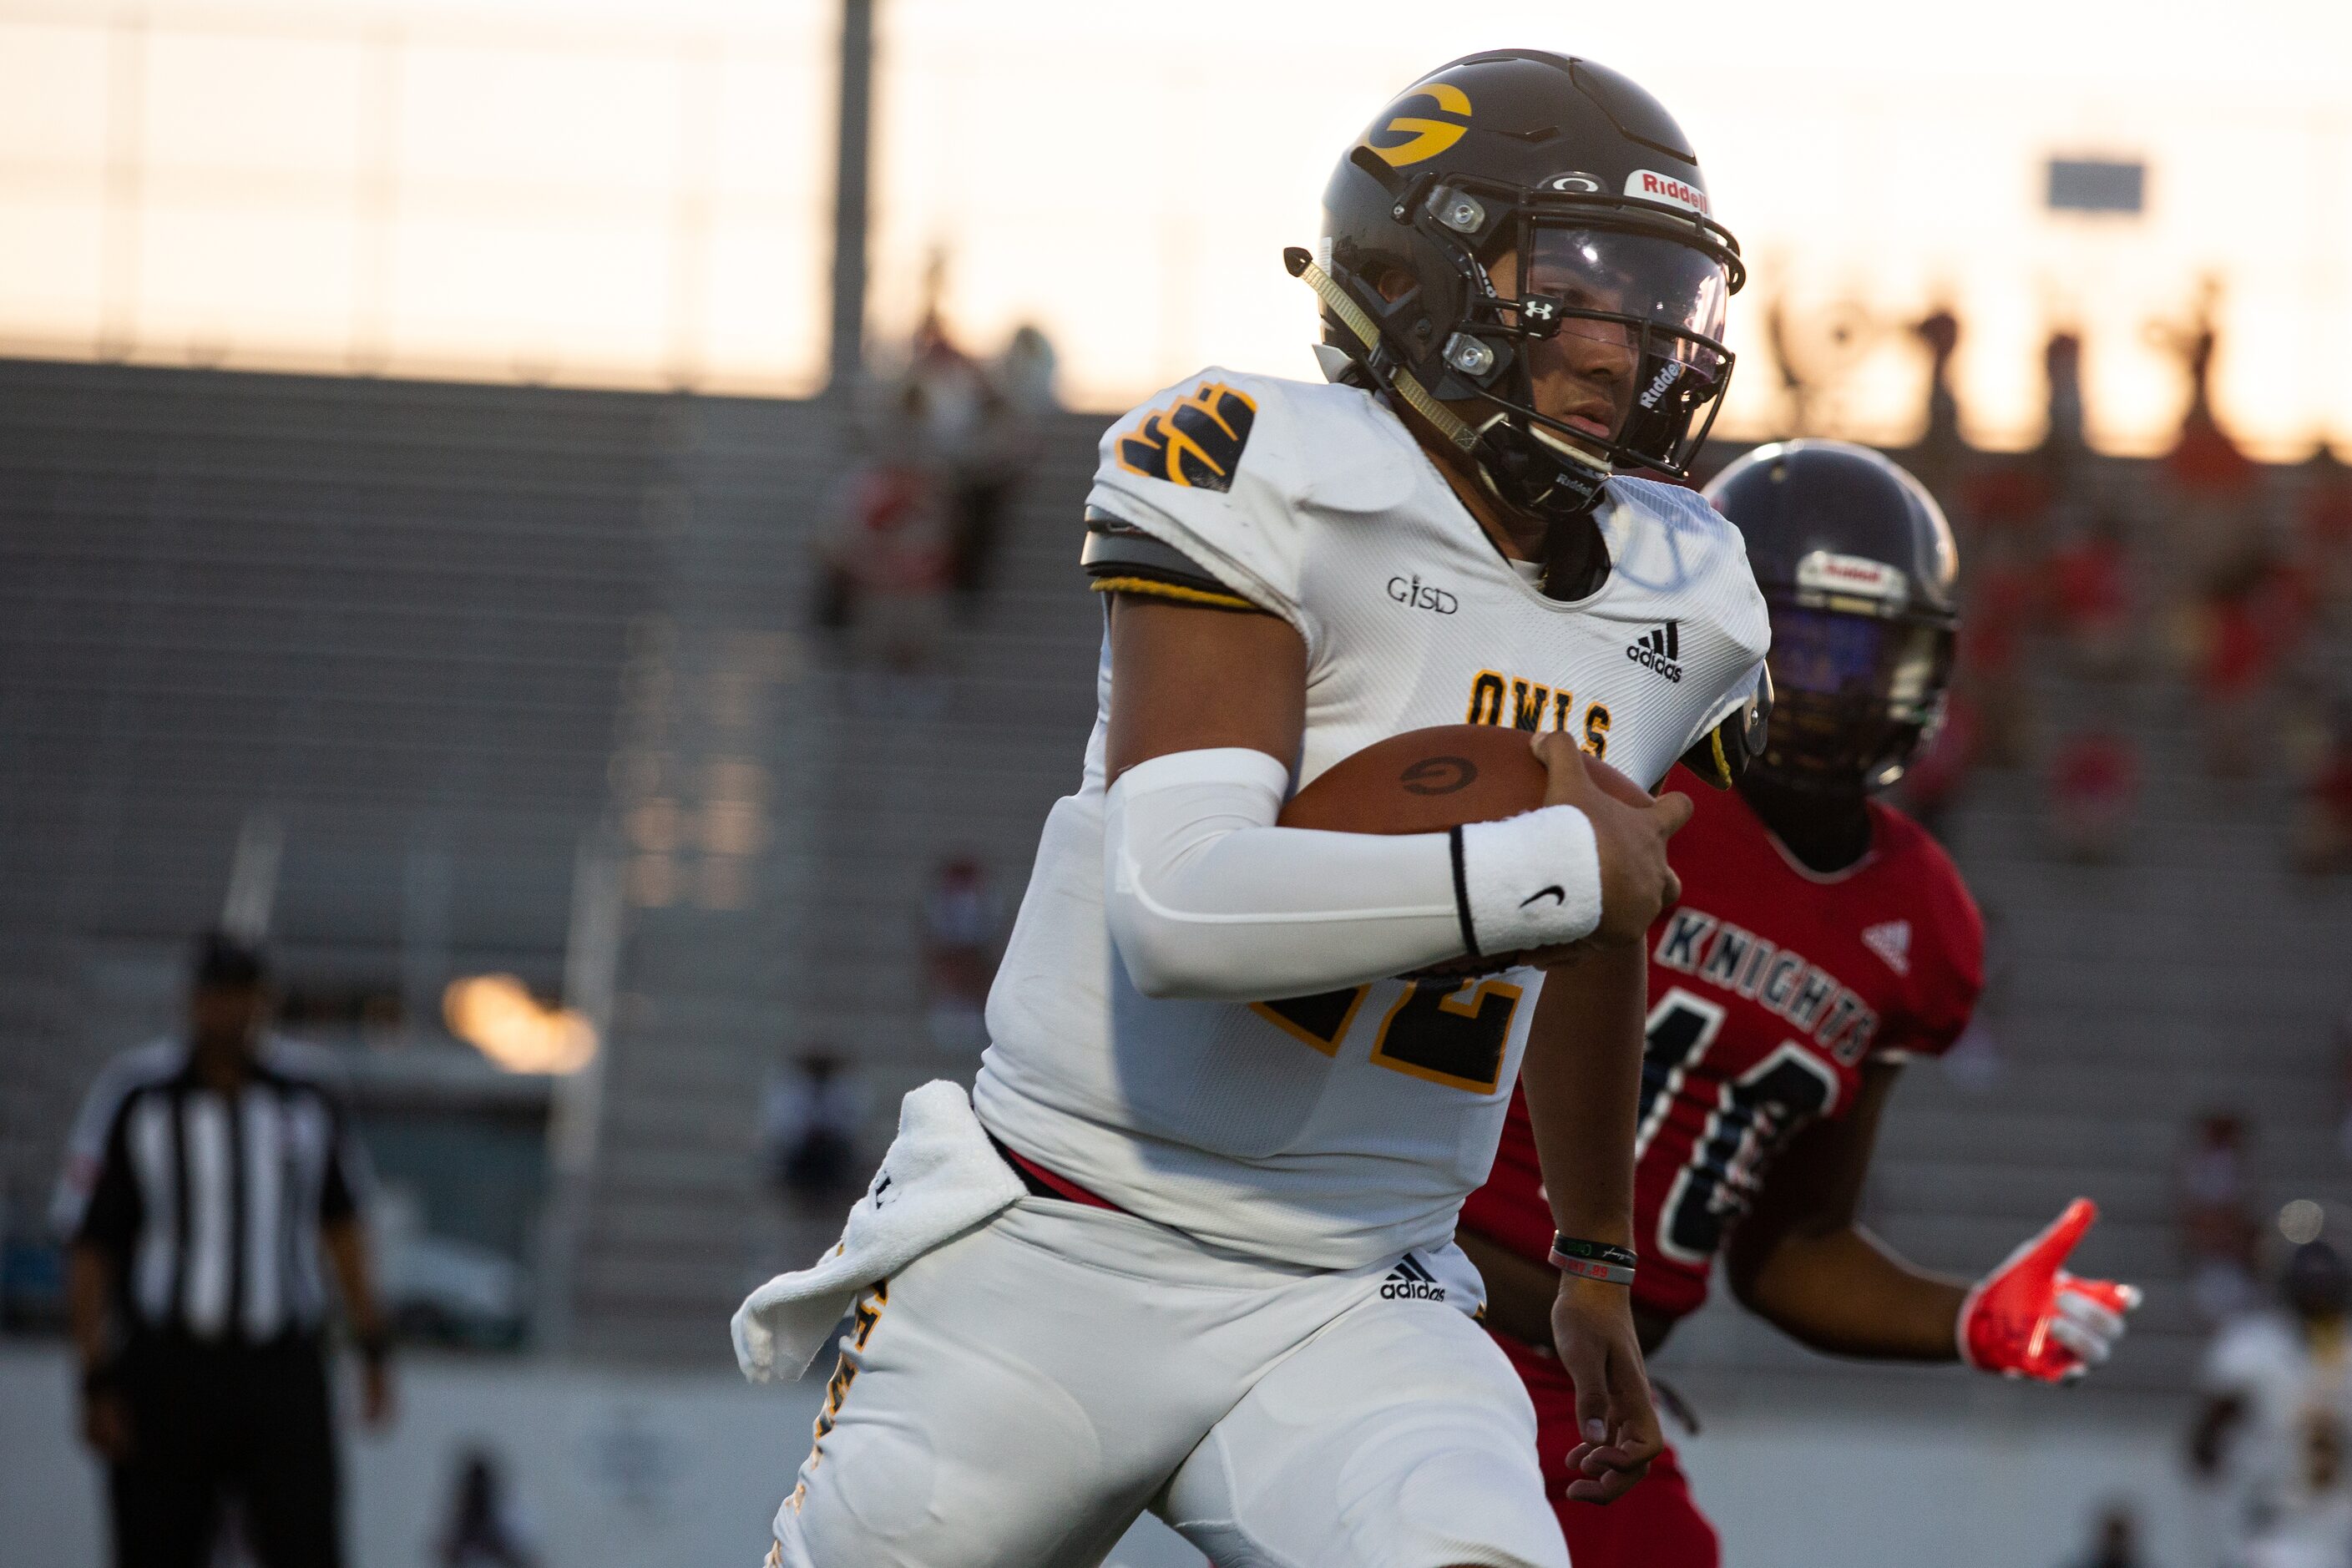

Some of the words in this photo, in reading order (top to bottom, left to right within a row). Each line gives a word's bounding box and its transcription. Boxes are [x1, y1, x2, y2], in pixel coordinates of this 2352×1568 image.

[1641, 173, 1708, 215] Riddell
[1640, 362, 1681, 409] Ridde
[1626, 645, 1682, 683] adidas
[1652, 906, 1880, 1068] KNIGHTS
[1380, 1279, 1446, 1302] adidas
